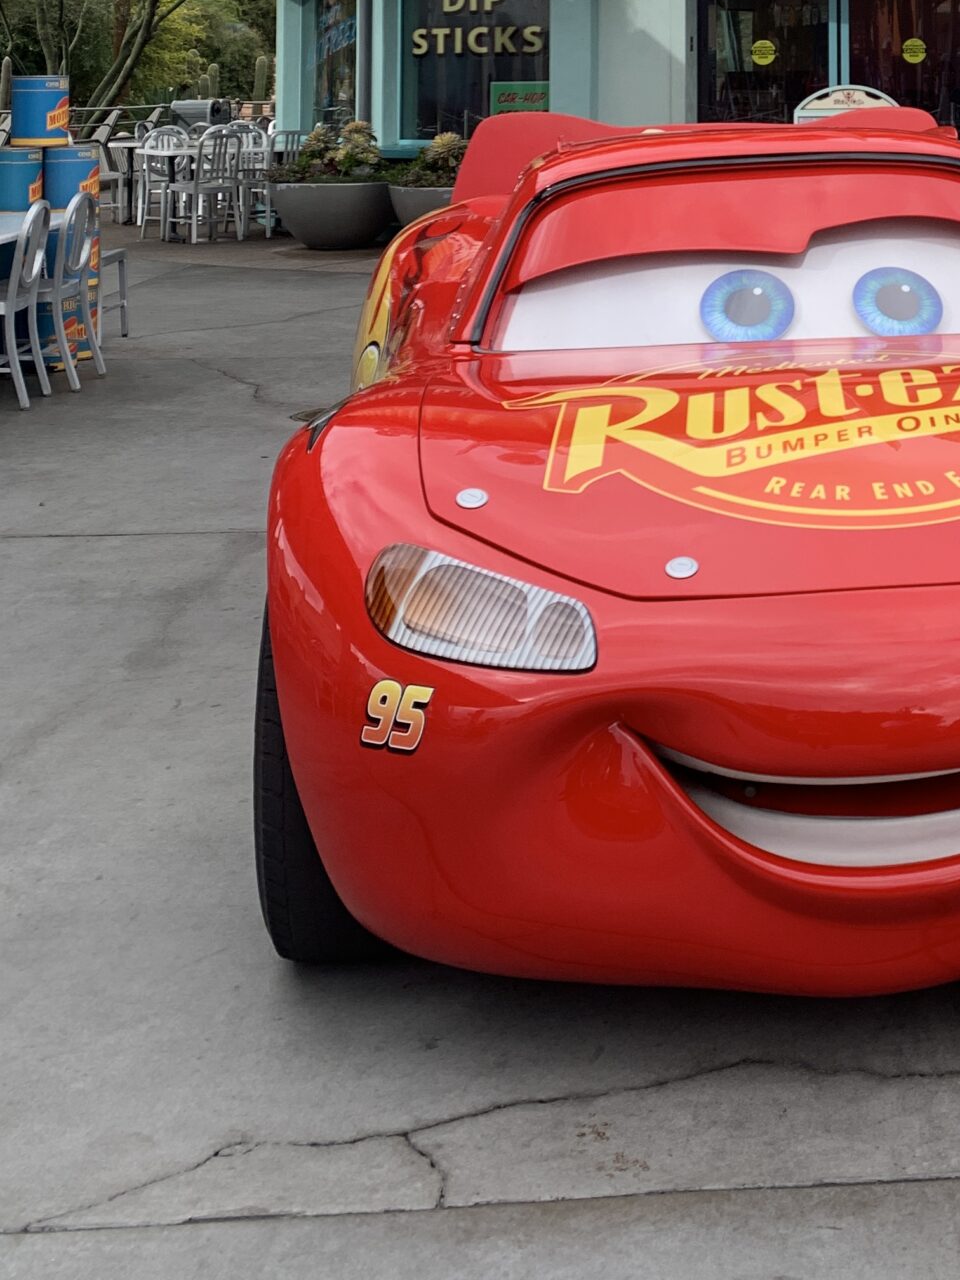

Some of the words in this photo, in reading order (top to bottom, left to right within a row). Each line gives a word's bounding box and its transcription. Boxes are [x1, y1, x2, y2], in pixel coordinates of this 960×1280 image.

[412, 25, 544, 56] STICKS
[725, 423, 874, 468] BUMPER
[763, 474, 852, 502] REAR
[872, 478, 936, 501] END
[361, 679, 435, 751] 95
